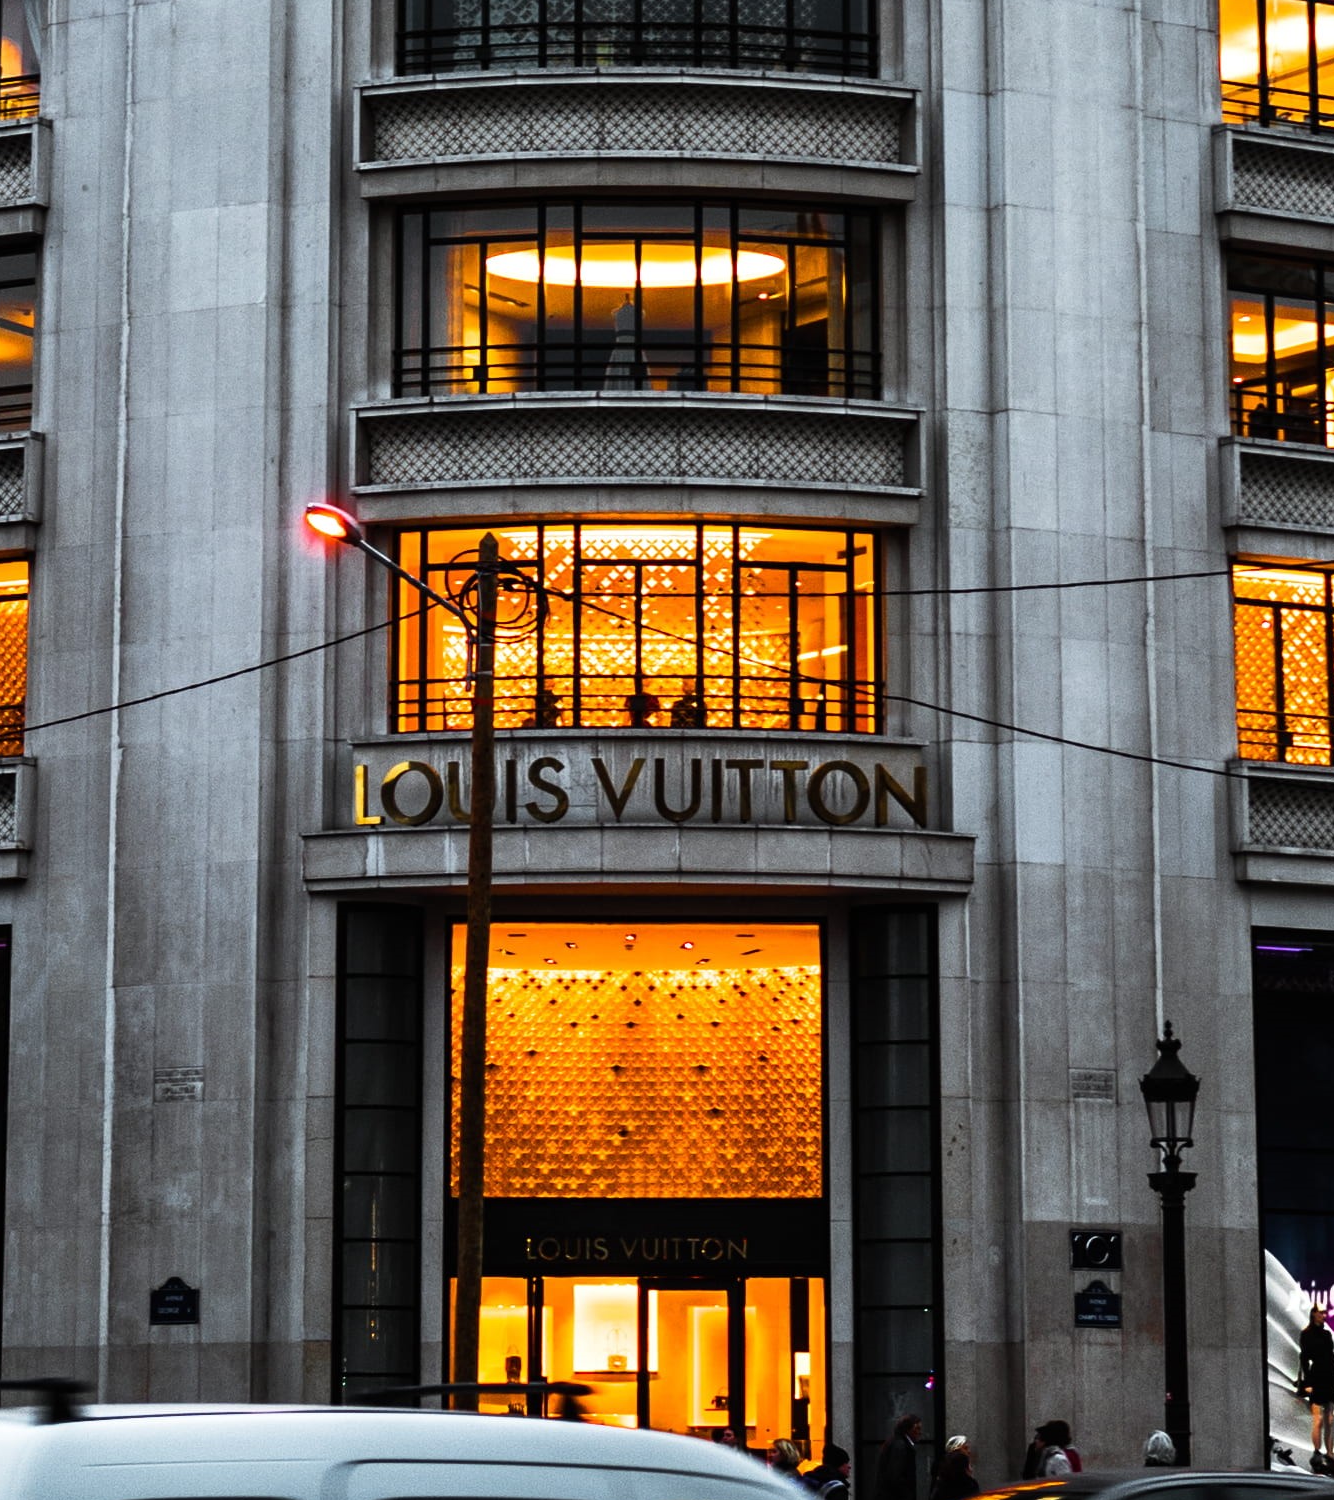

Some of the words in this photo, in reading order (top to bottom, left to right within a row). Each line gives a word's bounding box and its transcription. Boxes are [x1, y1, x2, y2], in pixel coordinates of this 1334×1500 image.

[354, 757, 569, 827] LOUIS
[592, 758, 927, 827] VUITTON
[525, 1237, 610, 1261] LOUIS
[619, 1237, 749, 1261] VUITTON
